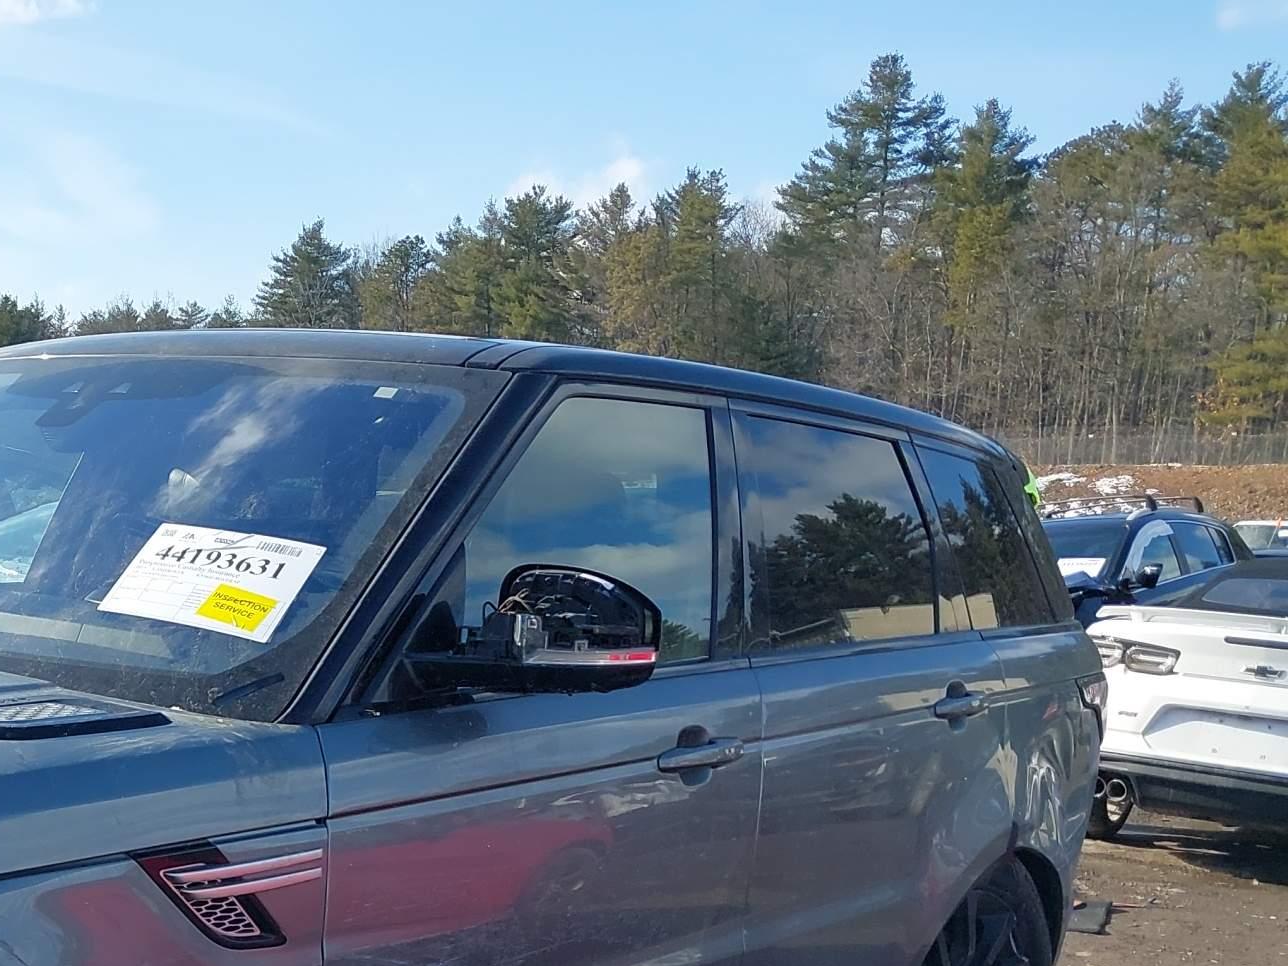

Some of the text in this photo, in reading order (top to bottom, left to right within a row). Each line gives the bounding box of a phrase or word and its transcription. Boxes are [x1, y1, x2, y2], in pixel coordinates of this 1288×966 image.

[155, 544, 286, 580] 44193631
[212, 592, 269, 613] INSPECTION
[213, 602, 255, 619] SERVICE
